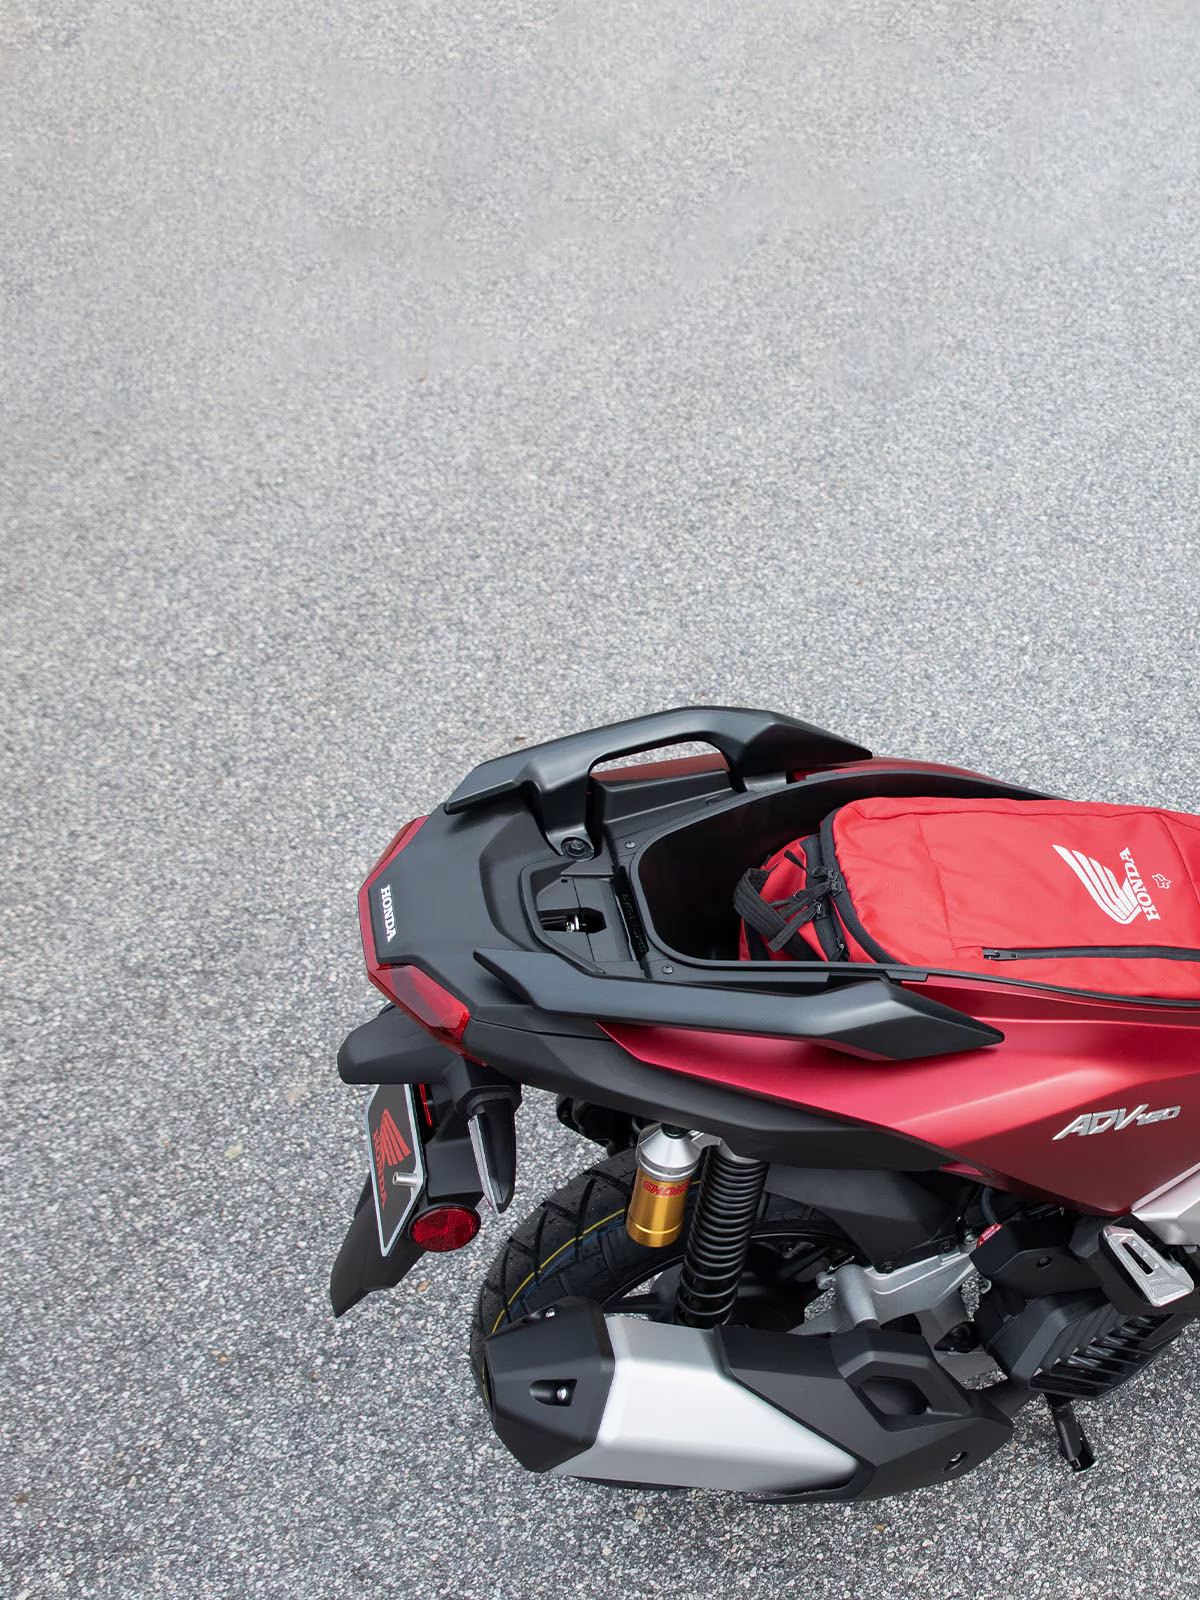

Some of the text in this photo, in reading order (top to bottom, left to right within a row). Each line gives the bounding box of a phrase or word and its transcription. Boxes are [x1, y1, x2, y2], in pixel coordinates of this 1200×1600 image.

[380, 884, 397, 942] HONDA
[1119, 846, 1161, 921] HONDA
[373, 1128, 387, 1210] HONDA
